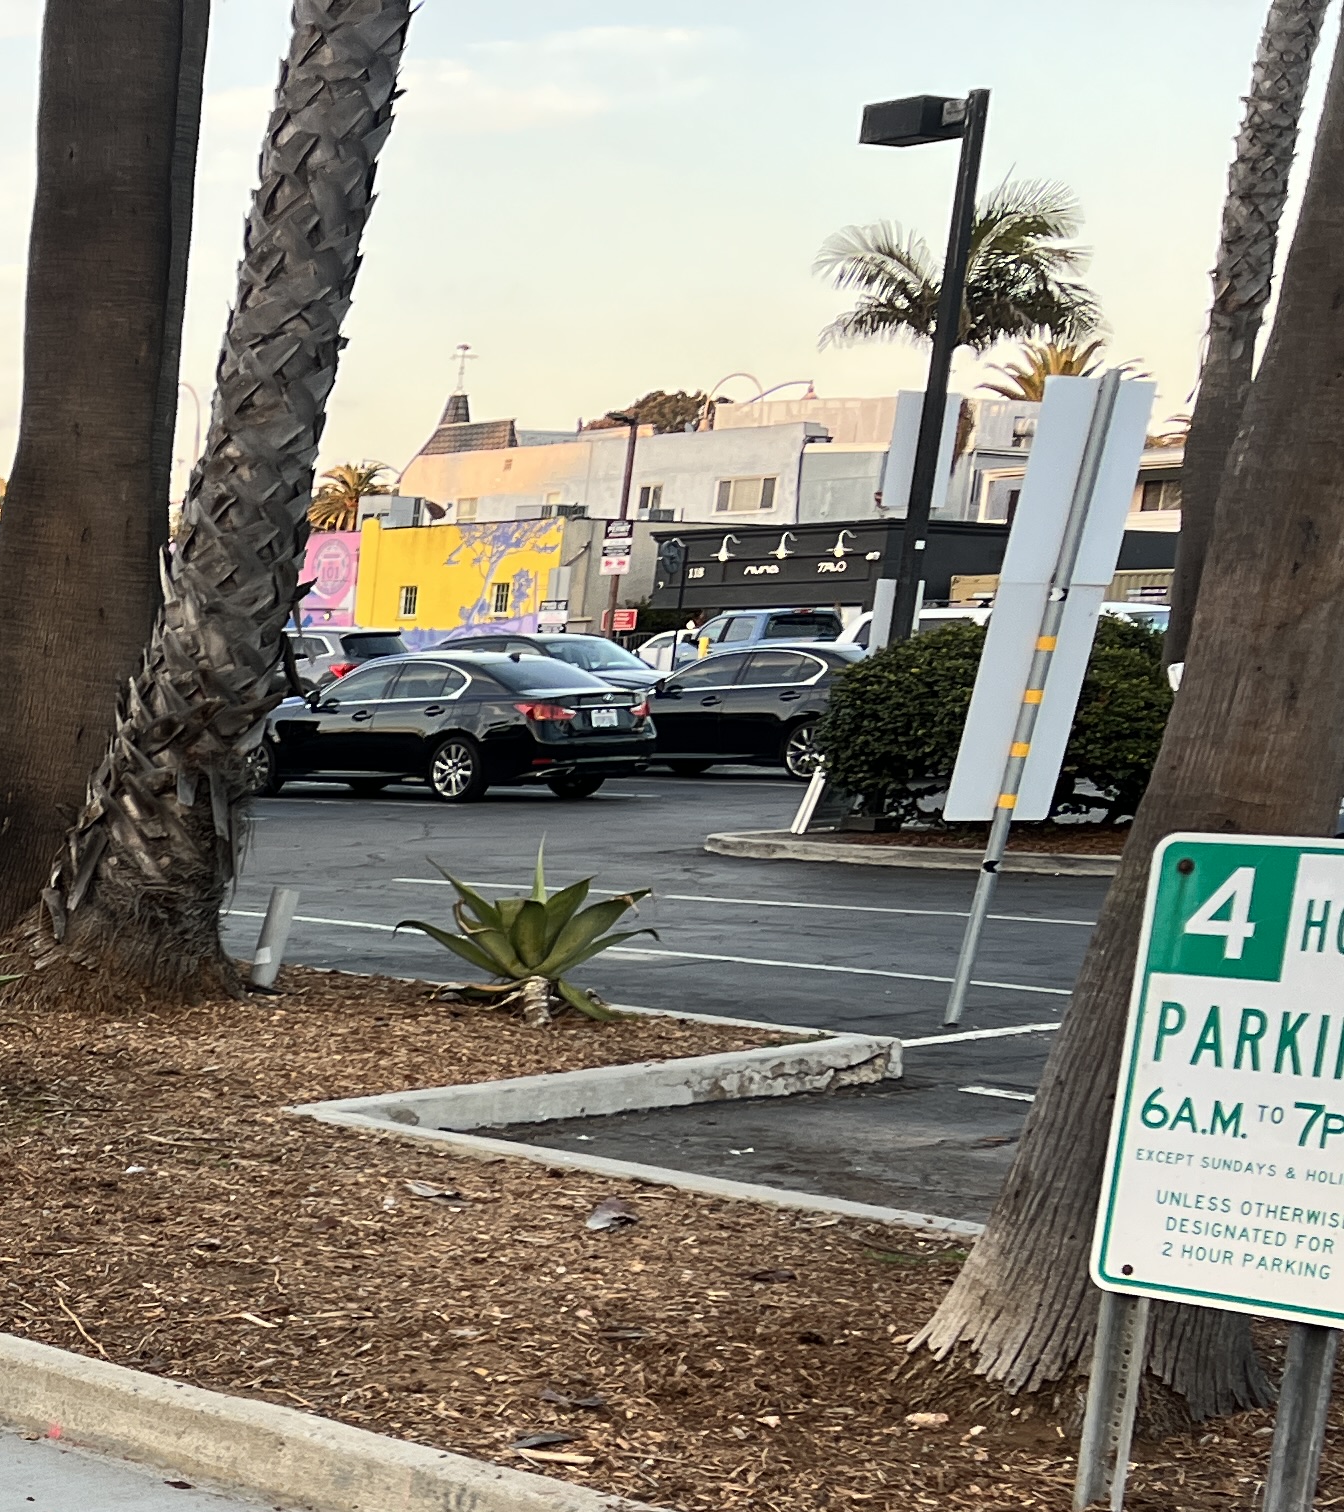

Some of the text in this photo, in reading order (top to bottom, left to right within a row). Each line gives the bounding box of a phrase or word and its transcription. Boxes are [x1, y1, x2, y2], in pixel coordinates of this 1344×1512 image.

[1183, 866, 1344, 961] 4 H
[1258, 1104, 1285, 1125] TO
[1136, 1147, 1194, 1168] EXCEPT
[1200, 1156, 1278, 1178] SUNDAYS
[1285, 1166, 1297, 1180] &
[1156, 1189, 1344, 1230] UNLESS OTHERWIS
[1165, 1216, 1336, 1255] DESIGNATED FOR
[1161, 1241, 1332, 1281] 2 HOUR PARKING
